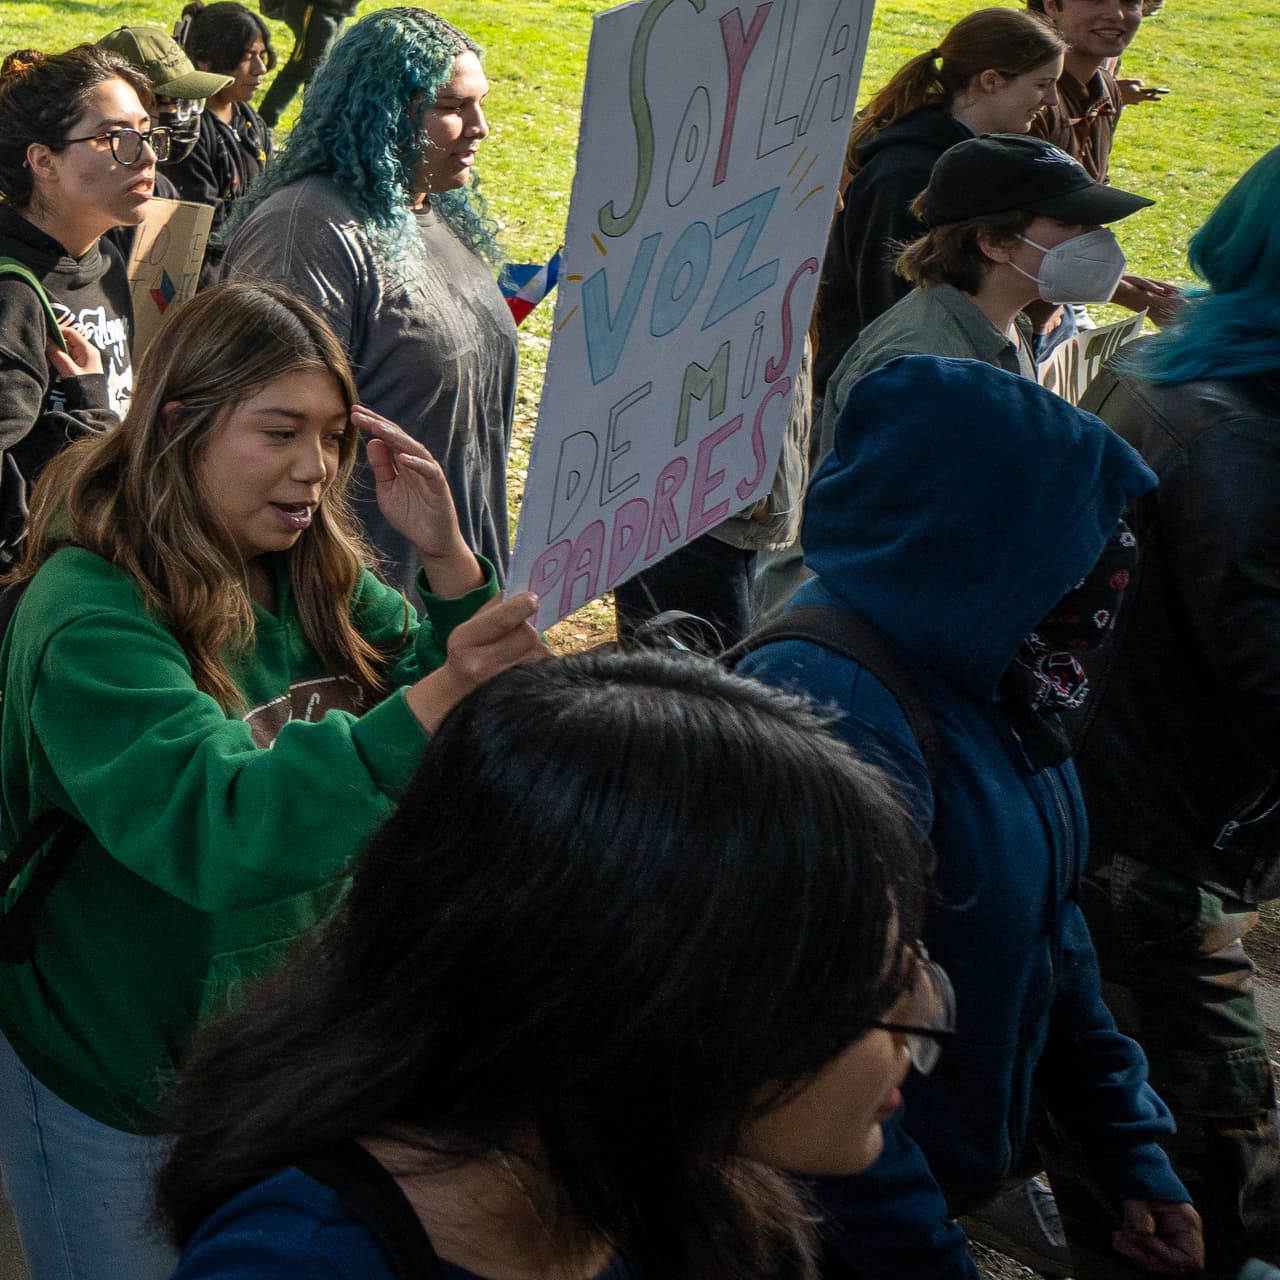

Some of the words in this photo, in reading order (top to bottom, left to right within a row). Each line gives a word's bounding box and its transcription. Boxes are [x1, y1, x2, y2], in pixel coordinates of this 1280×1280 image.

[580, 186, 782, 387] VOZ
[528, 376, 791, 624] PADRES
[545, 381, 653, 545] DE
